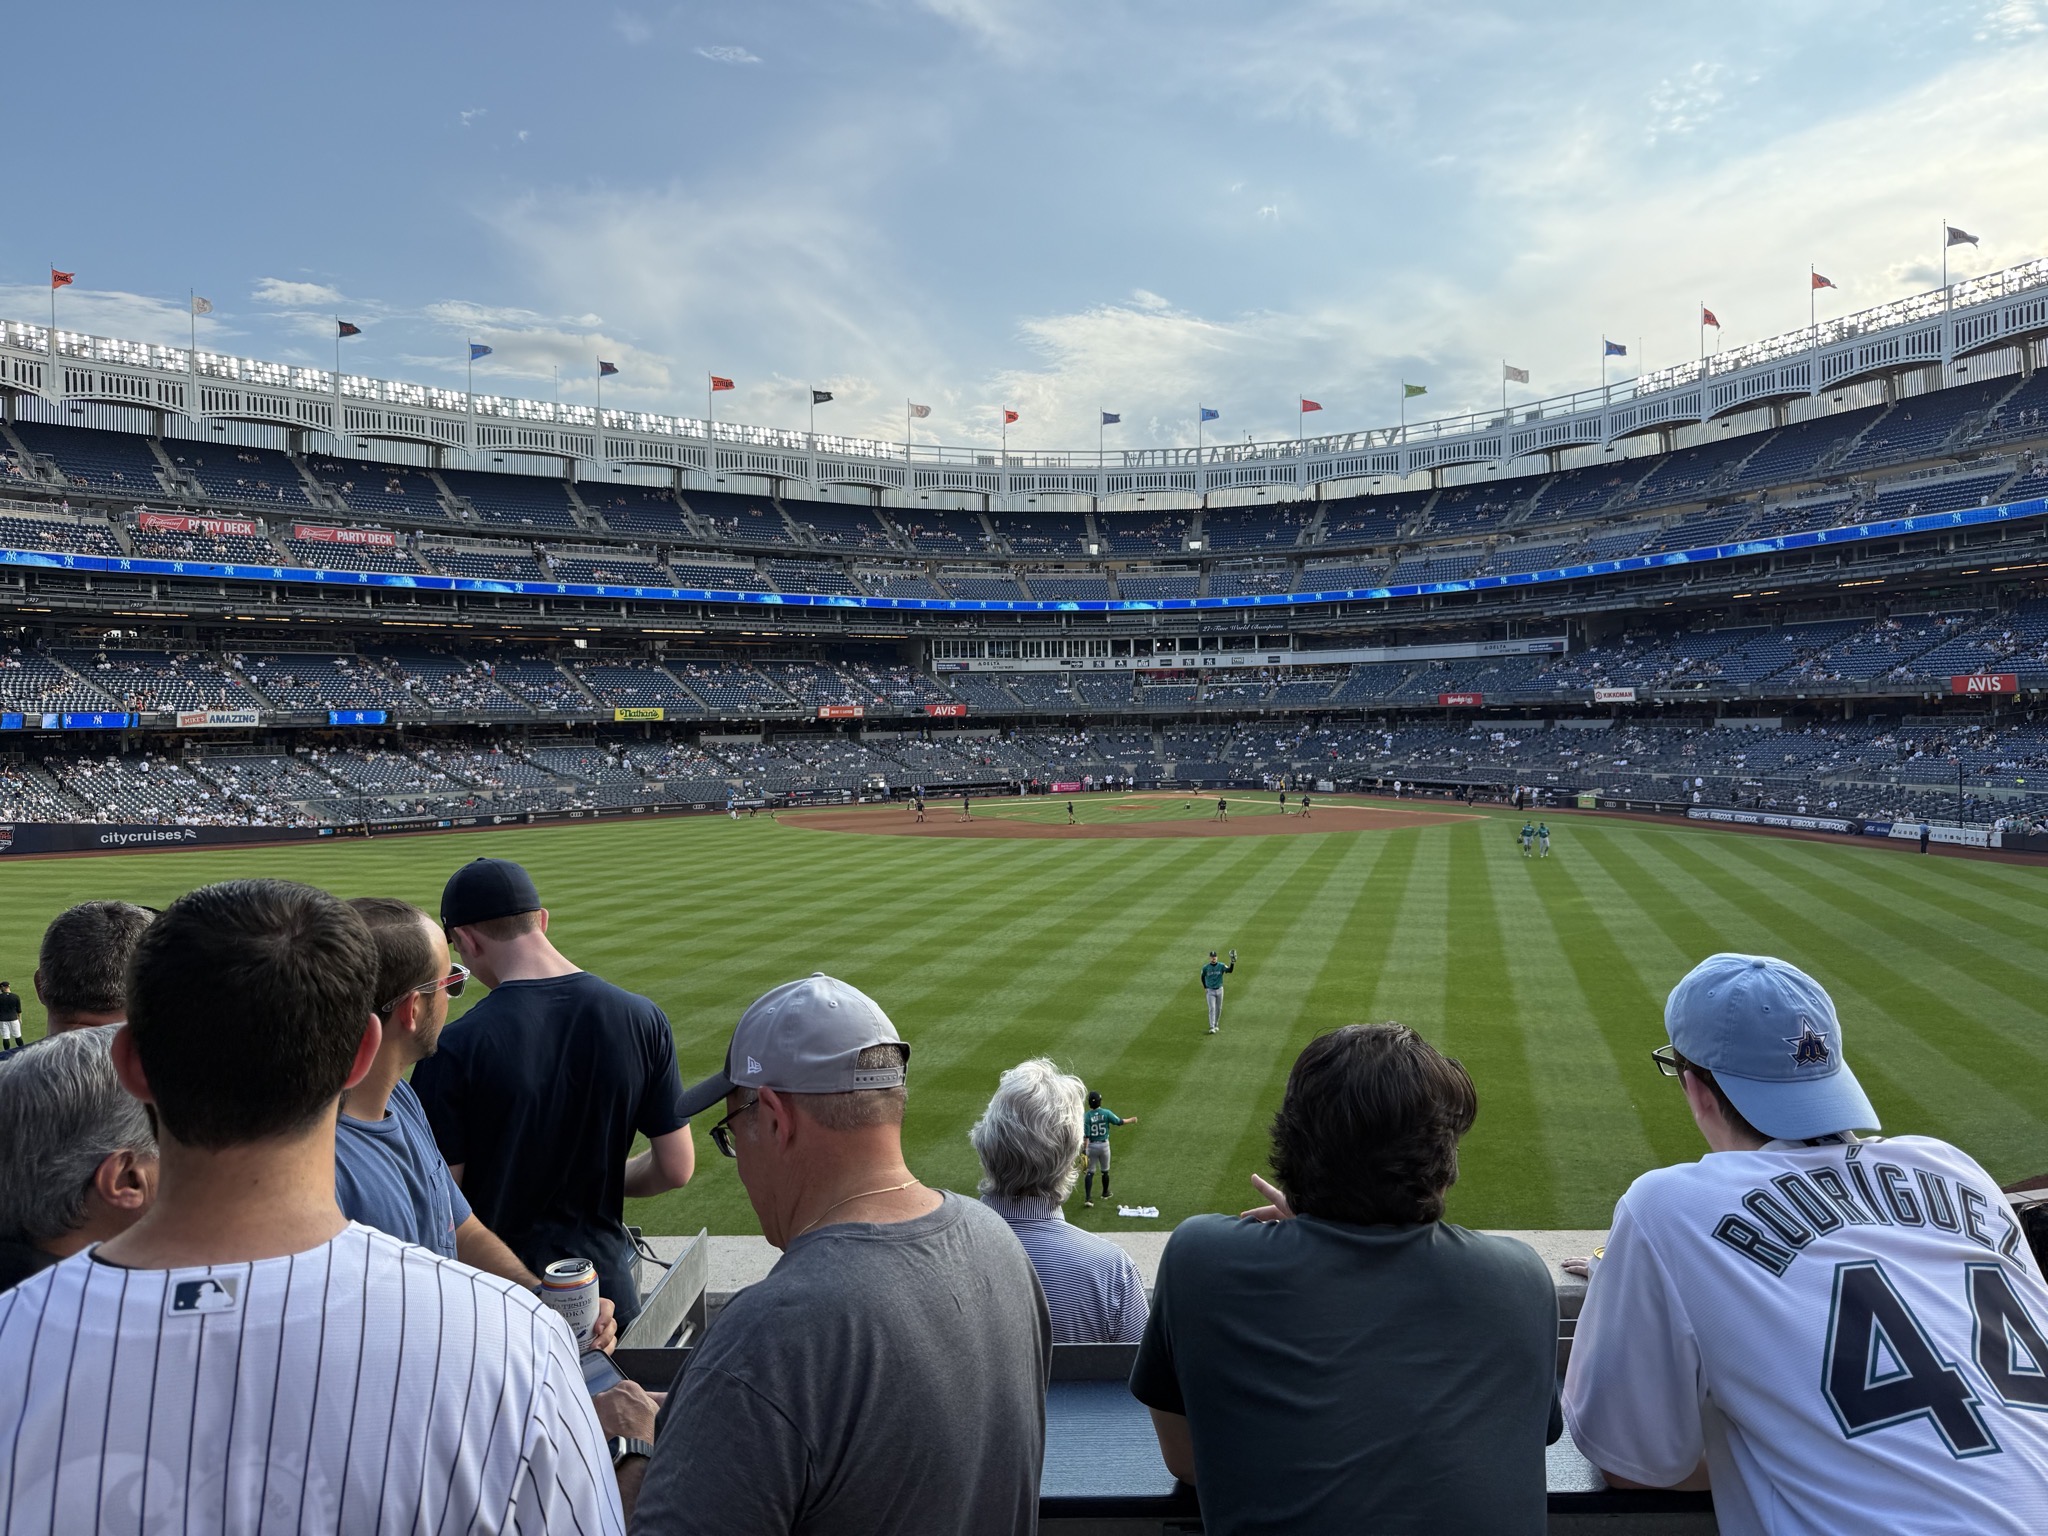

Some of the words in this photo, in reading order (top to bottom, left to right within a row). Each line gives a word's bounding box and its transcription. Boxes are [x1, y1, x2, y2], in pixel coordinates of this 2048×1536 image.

[188, 519, 222, 533] PARTY
[223, 520, 252, 534] DECK
[337, 530, 367, 543] PARTY
[367, 532, 393, 545] DECK
[1250, 623, 1284, 633] Champions
[1967, 676, 2002, 692] AVIS
[1602, 691, 1633, 699] KIKKOMAN
[619, 708, 659, 719] Nathan's
[934, 706, 957, 715] AVIS
[184, 715, 205, 724] MIKE'S
[209, 714, 256, 724] AMAZING
[100, 829, 182, 845] citycruises
[1090, 1122, 1107, 1137] 95
[563, 1310, 585, 1318] DKA
[1820, 1258, 2048, 1460] 44
